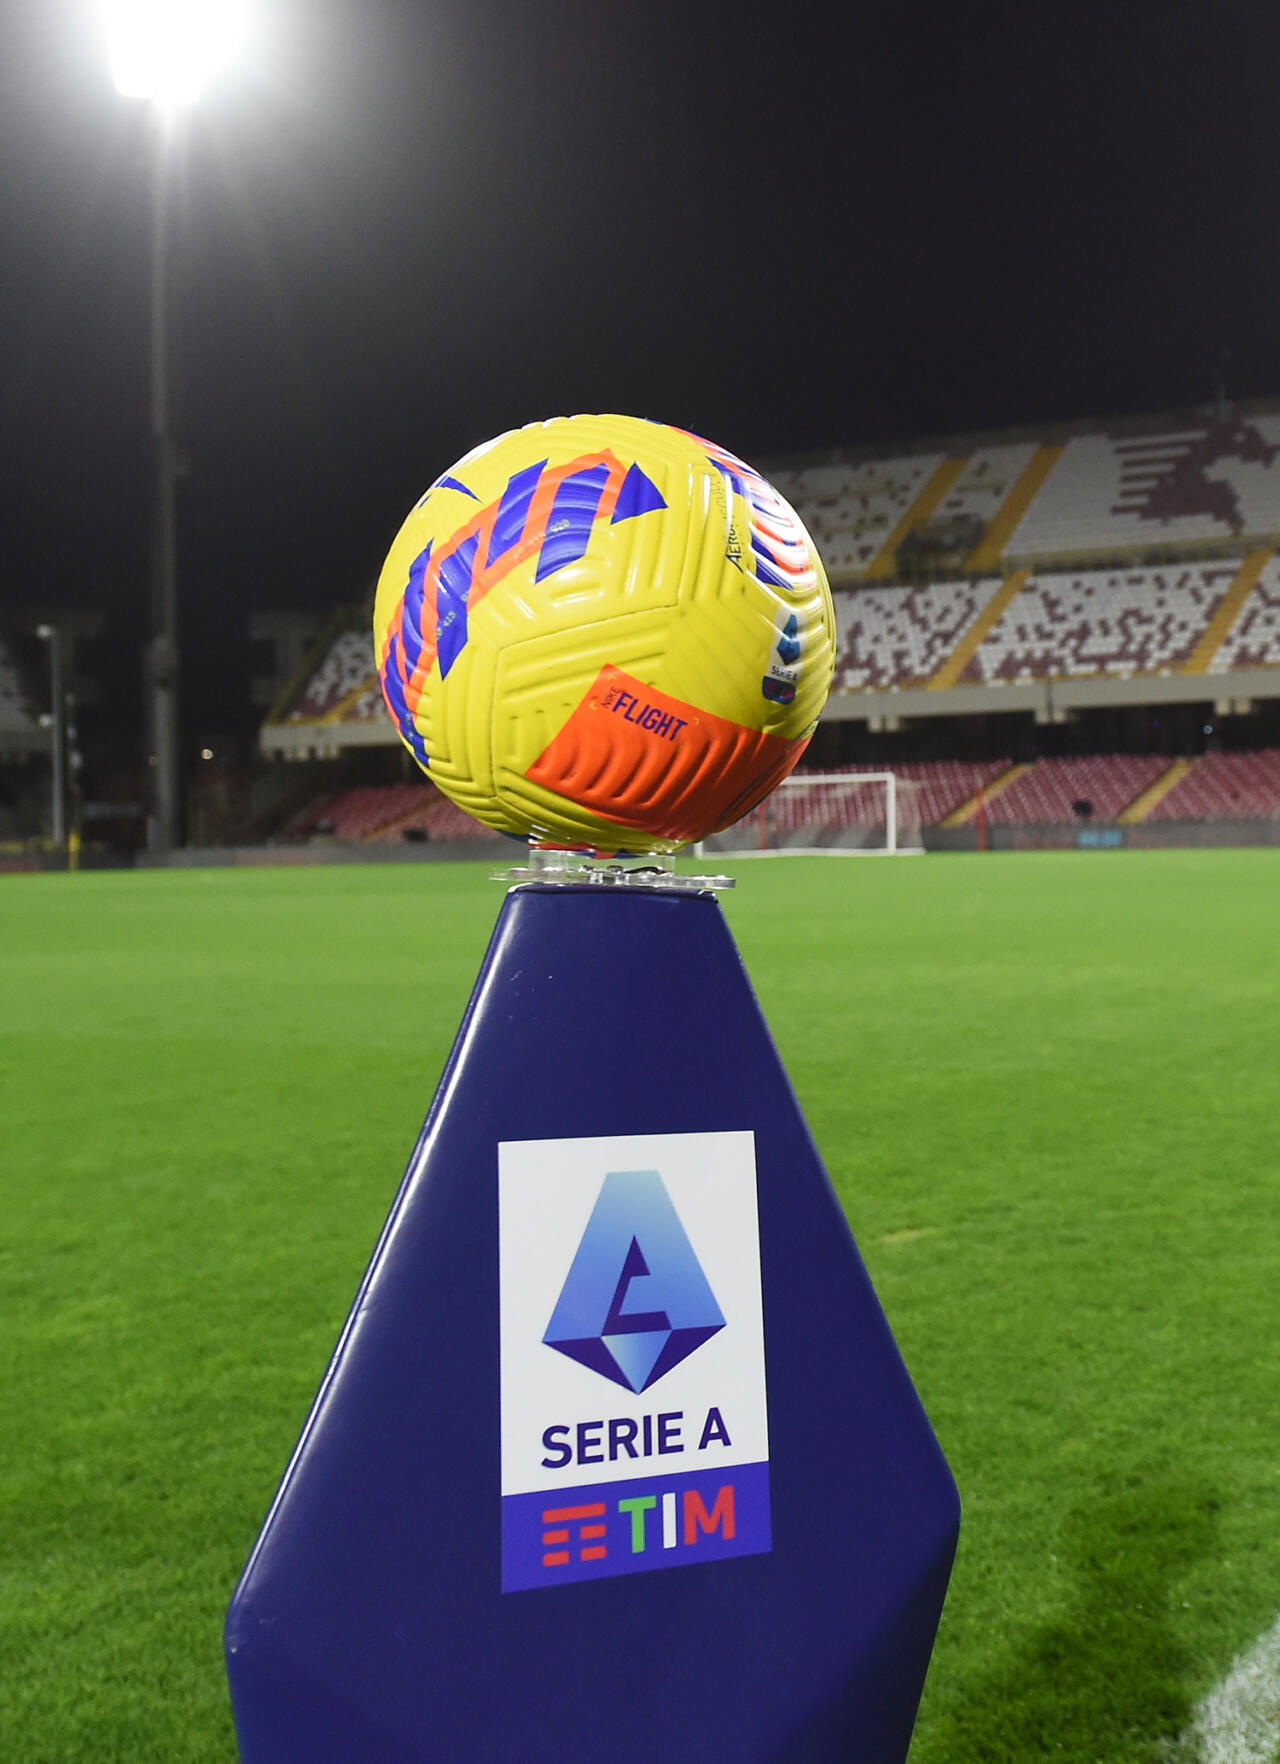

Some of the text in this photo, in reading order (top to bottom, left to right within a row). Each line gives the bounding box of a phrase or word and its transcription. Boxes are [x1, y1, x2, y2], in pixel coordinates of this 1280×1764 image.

[601, 686, 618, 709] NIKE
[612, 691, 688, 741] FLIGHT
[541, 1407, 732, 1469] SERIE A
[618, 1485, 736, 1554] TIM
